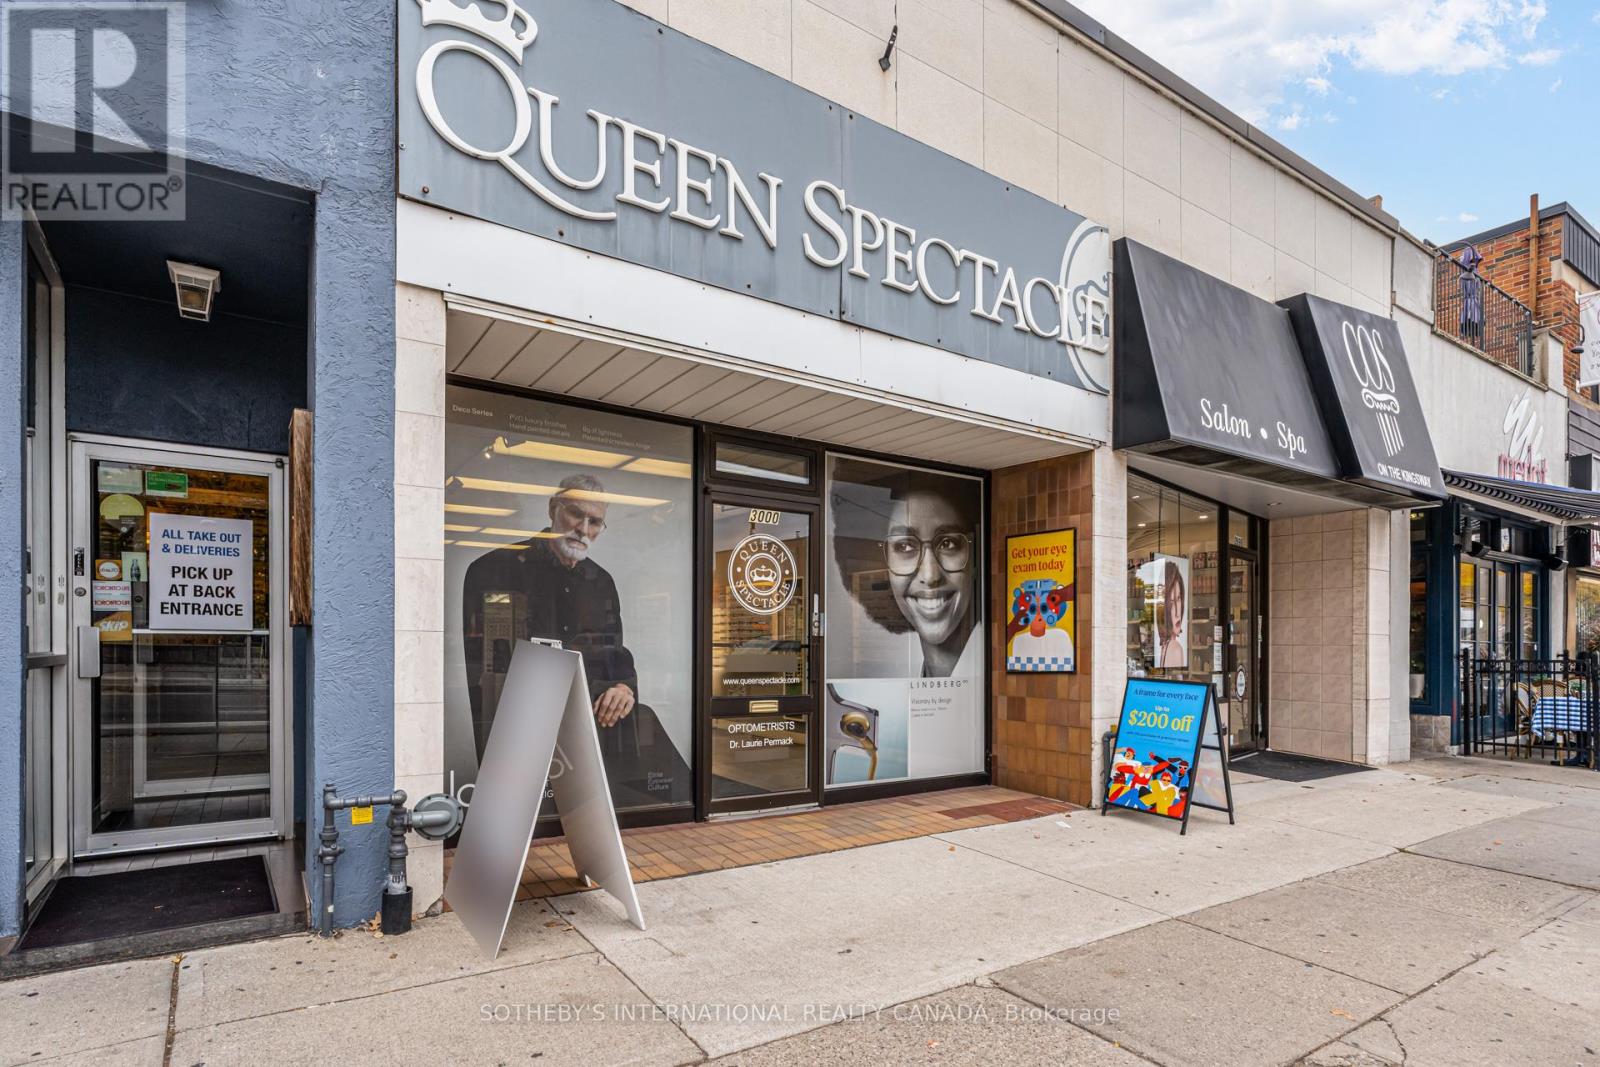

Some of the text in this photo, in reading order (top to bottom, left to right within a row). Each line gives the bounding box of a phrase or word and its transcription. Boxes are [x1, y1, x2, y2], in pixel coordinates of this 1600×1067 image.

[416, 39, 1109, 354] QUEEN SPECTACLE
[1342, 320, 1395, 393] COS
[471, 407, 493, 417] Series
[1200, 398, 1307, 460] Salon Spa
[1377, 462, 1432, 488] ON THE KINGSWAY
[750, 509, 779, 524] 3000
[162, 529, 241, 543] ALL TAKE OUT
[162, 543, 240, 557] & DELIVERIES
[740, 541, 788, 563] QUEEN
[1011, 543, 1067, 561] Get your eye
[171, 566, 233, 580] PICK UP
[1012, 559, 1065, 573] exam today
[168, 584, 235, 599] AT BACK
[736, 580, 791, 608] SPECTACLE
[160, 602, 244, 616] ENTRANCE
[910, 680, 961, 689] LINDBERG
[1156, 690, 1166, 698] for
[1167, 692, 1184, 700] every
[1184, 692, 1199, 701] face
[728, 721, 795, 734] OPTOMETRISTS
[1128, 709, 1195, 732] $200 off
[729, 737, 794, 749] Dr. Laurie Permack
